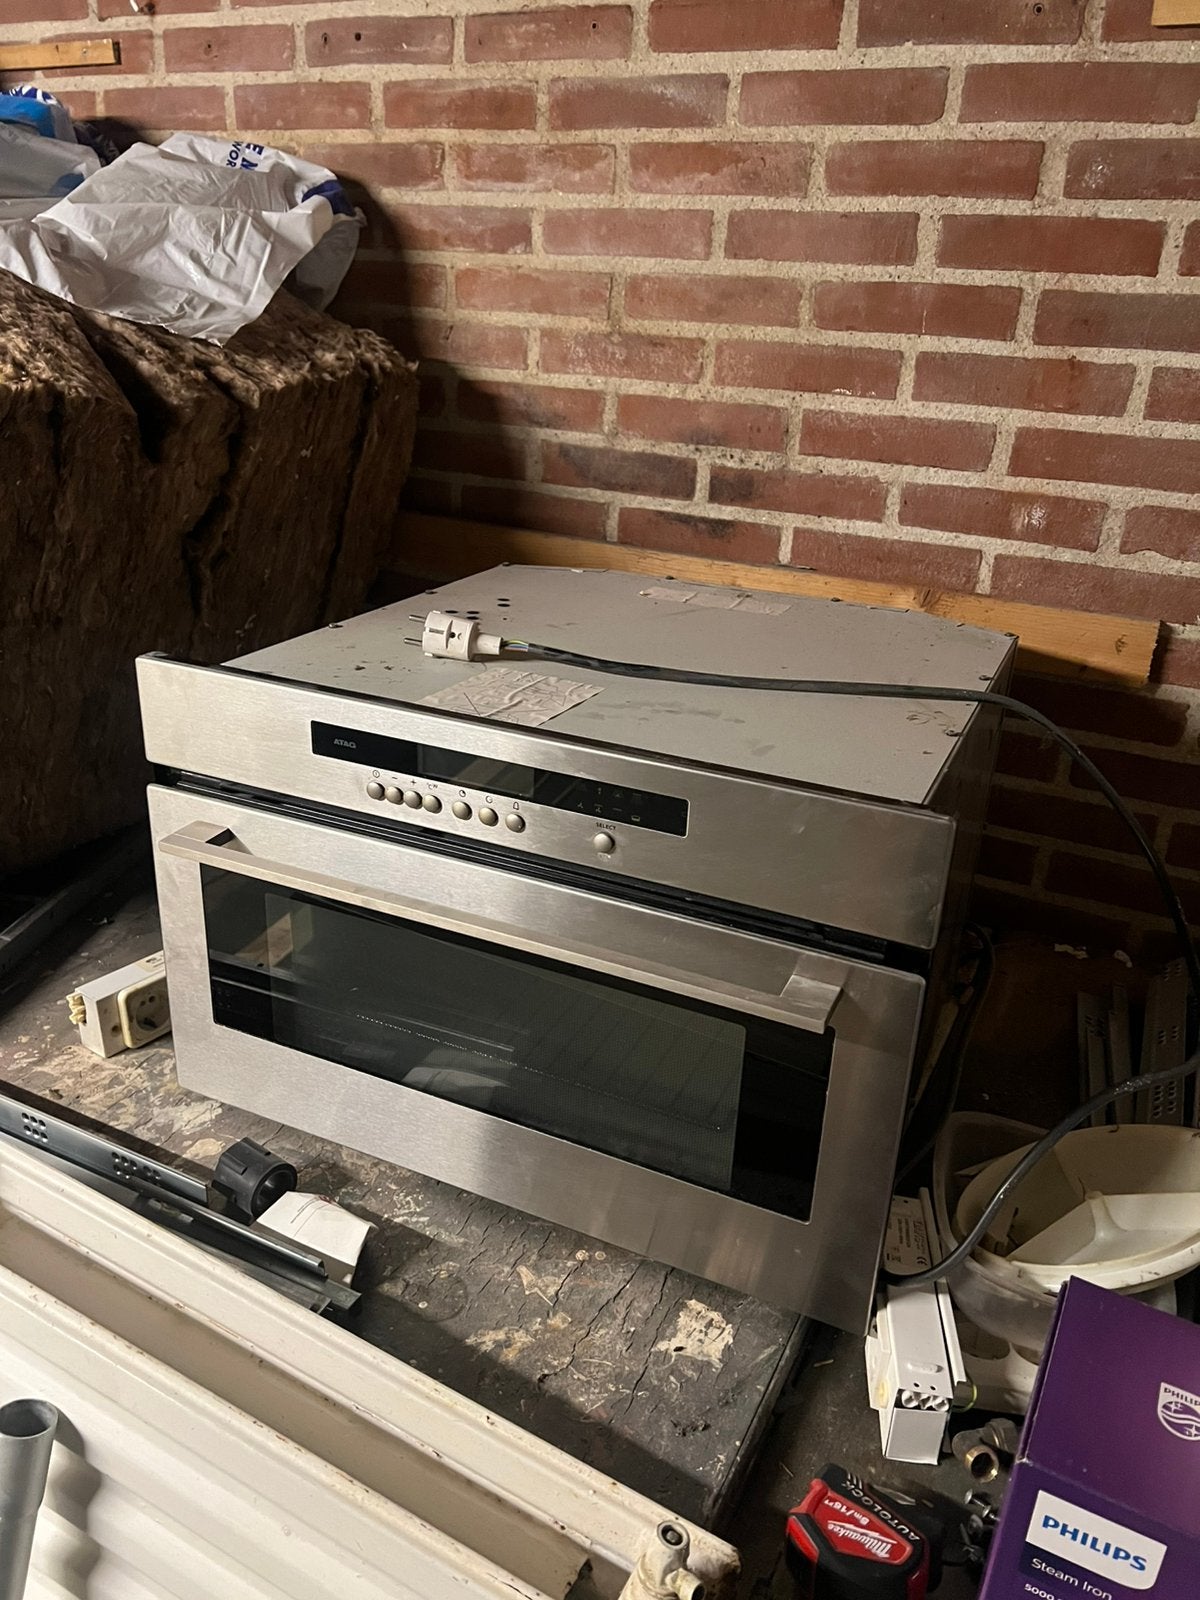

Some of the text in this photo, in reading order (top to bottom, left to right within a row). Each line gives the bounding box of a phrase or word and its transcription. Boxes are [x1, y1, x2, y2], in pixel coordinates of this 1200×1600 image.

[595, 822, 616, 831] SELECT
[842, 1480, 920, 1541] AUTOLOCK
[827, 1523, 893, 1558] Milwaukee
[1041, 1514, 1147, 1572] PHILIPS
[1024, 1583, 1055, 1600] 5000
[1031, 1557, 1113, 1600] Steam Iron
